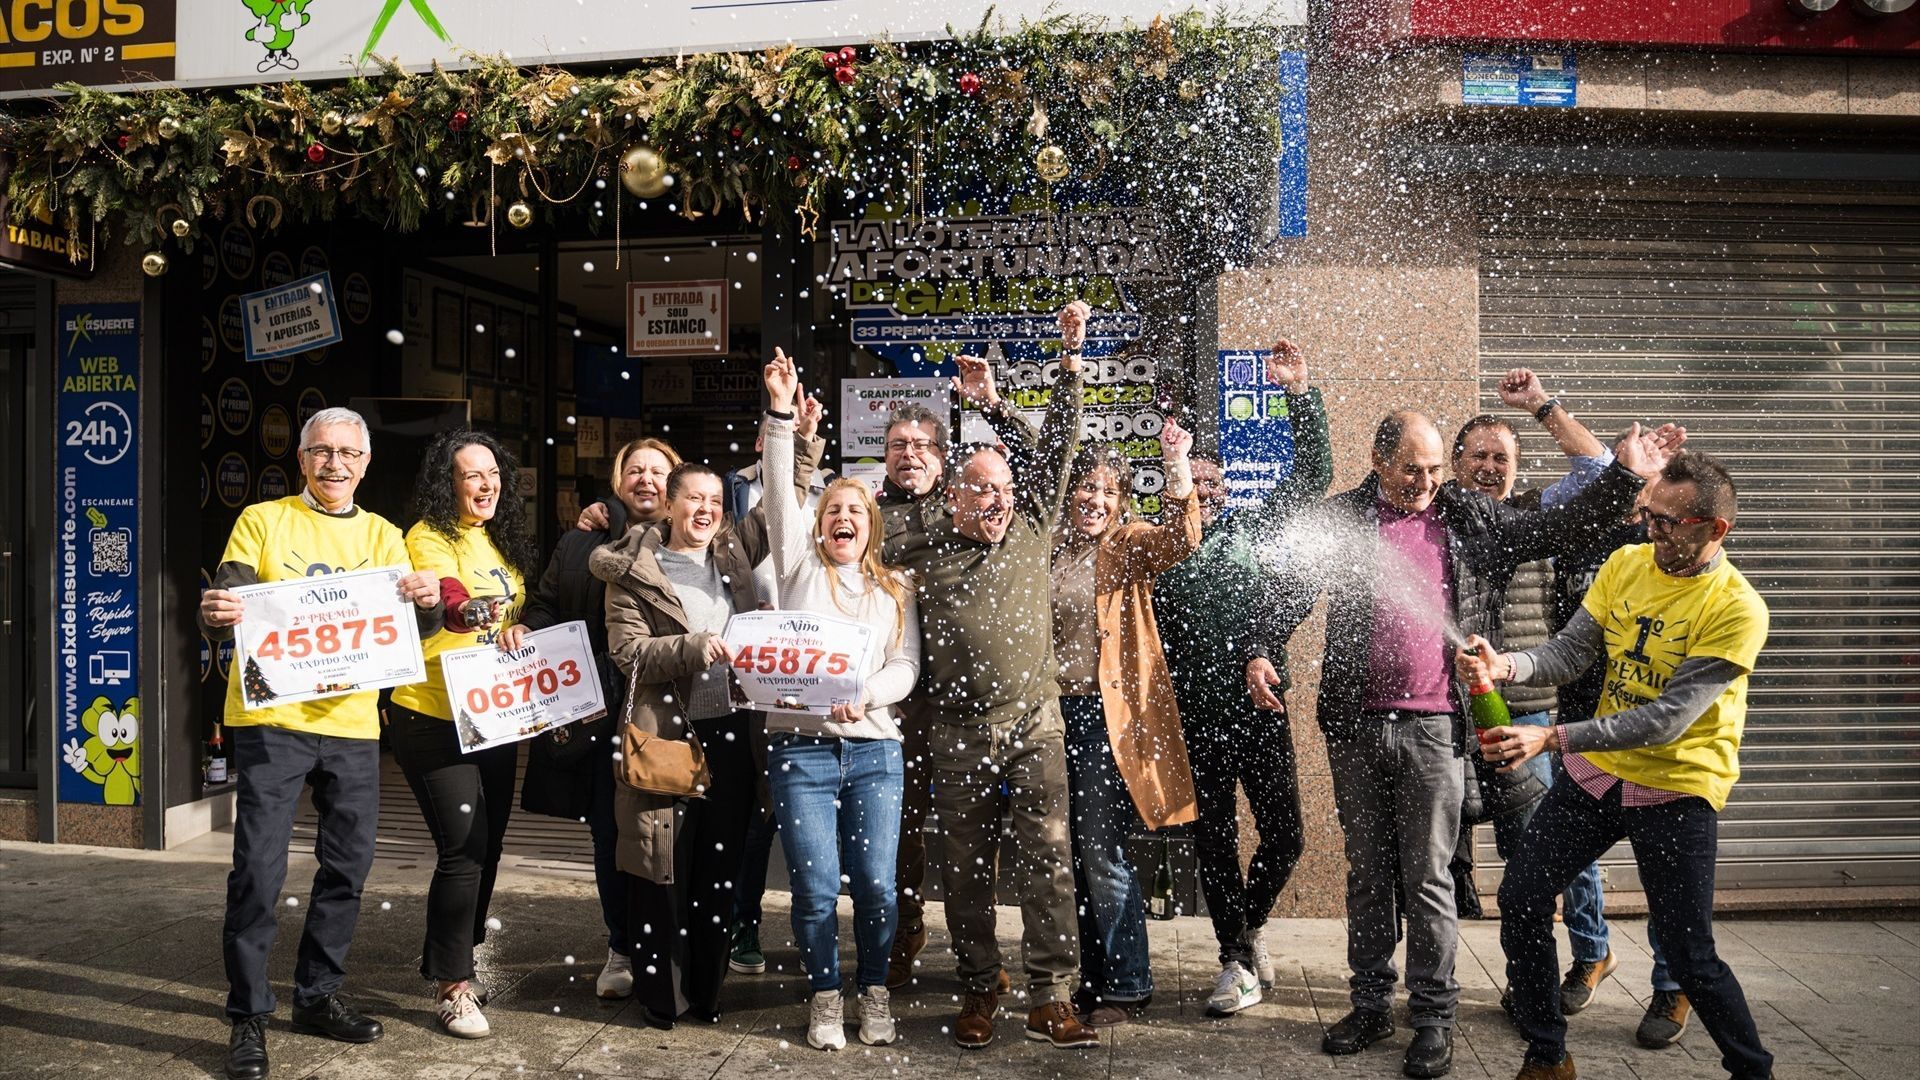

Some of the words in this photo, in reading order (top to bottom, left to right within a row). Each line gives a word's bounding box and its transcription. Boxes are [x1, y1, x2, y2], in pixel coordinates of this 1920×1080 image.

[42, 49, 75, 66] EXP.
[104, 46, 115, 62] 2
[839, 223, 884, 250] LA
[832, 244, 1162, 281] AFORTUNADA
[264, 286, 311, 310] ENTRADA
[652, 291, 703, 306] ENTRADA
[852, 283, 894, 303] DE
[893, 275, 1122, 313] GALICIA
[269, 306, 312, 327] LOTERÍAS
[667, 308, 688, 317] SOLO
[66, 319, 78, 331] EL
[93, 318, 135, 330] SUERTE
[265, 331, 273, 343] Y
[274, 319, 321, 341] APUESTAS
[648, 318, 706, 335] ESTANCO
[857, 326, 878, 337] 33
[881, 324, 951, 337] PREMIOS
[955, 322, 975, 335] EN
[982, 322, 1014, 335] LOS
[636, 339, 645, 348] NO
[646, 339, 678, 348] QUEDARSE
[679, 338, 687, 346] EN
[688, 338, 695, 346] LA
[696, 337, 719, 346] RAMPA
[80, 357, 119, 374] WEB
[62, 374, 137, 393] ABIERTA
[694, 374, 718, 391] EL
[860, 390, 890, 399] GRAN
[891, 389, 932, 398] PREMIO
[1083, 385, 1153, 405] 2023
[65, 420, 117, 446] 24h
[1080, 412, 1164, 440] RDO
[82, 498, 134, 506] ESCANEAME
[61, 466, 77, 732] www.elxdelasuerte.com
[307, 586, 348, 605] Niño
[293, 615, 305, 626] 2º
[308, 607, 360, 624] PREMIO
[785, 619, 820, 633] Niño
[88, 623, 134, 644] Seguro
[256, 615, 398, 661] 45875
[476, 634, 486, 644] EL
[766, 636, 778, 644] 2º
[779, 636, 823, 647] PREMIO
[1624, 615, 1665, 666] 1º
[503, 644, 536, 663] Niño
[733, 645, 850, 675] 45875
[290, 656, 340, 671] VENDIDO
[506, 658, 548, 681] PREMIO
[466, 659, 582, 715] 06703
[756, 676, 795, 685] VENDIDO
[496, 702, 537, 720] VENDIDO
